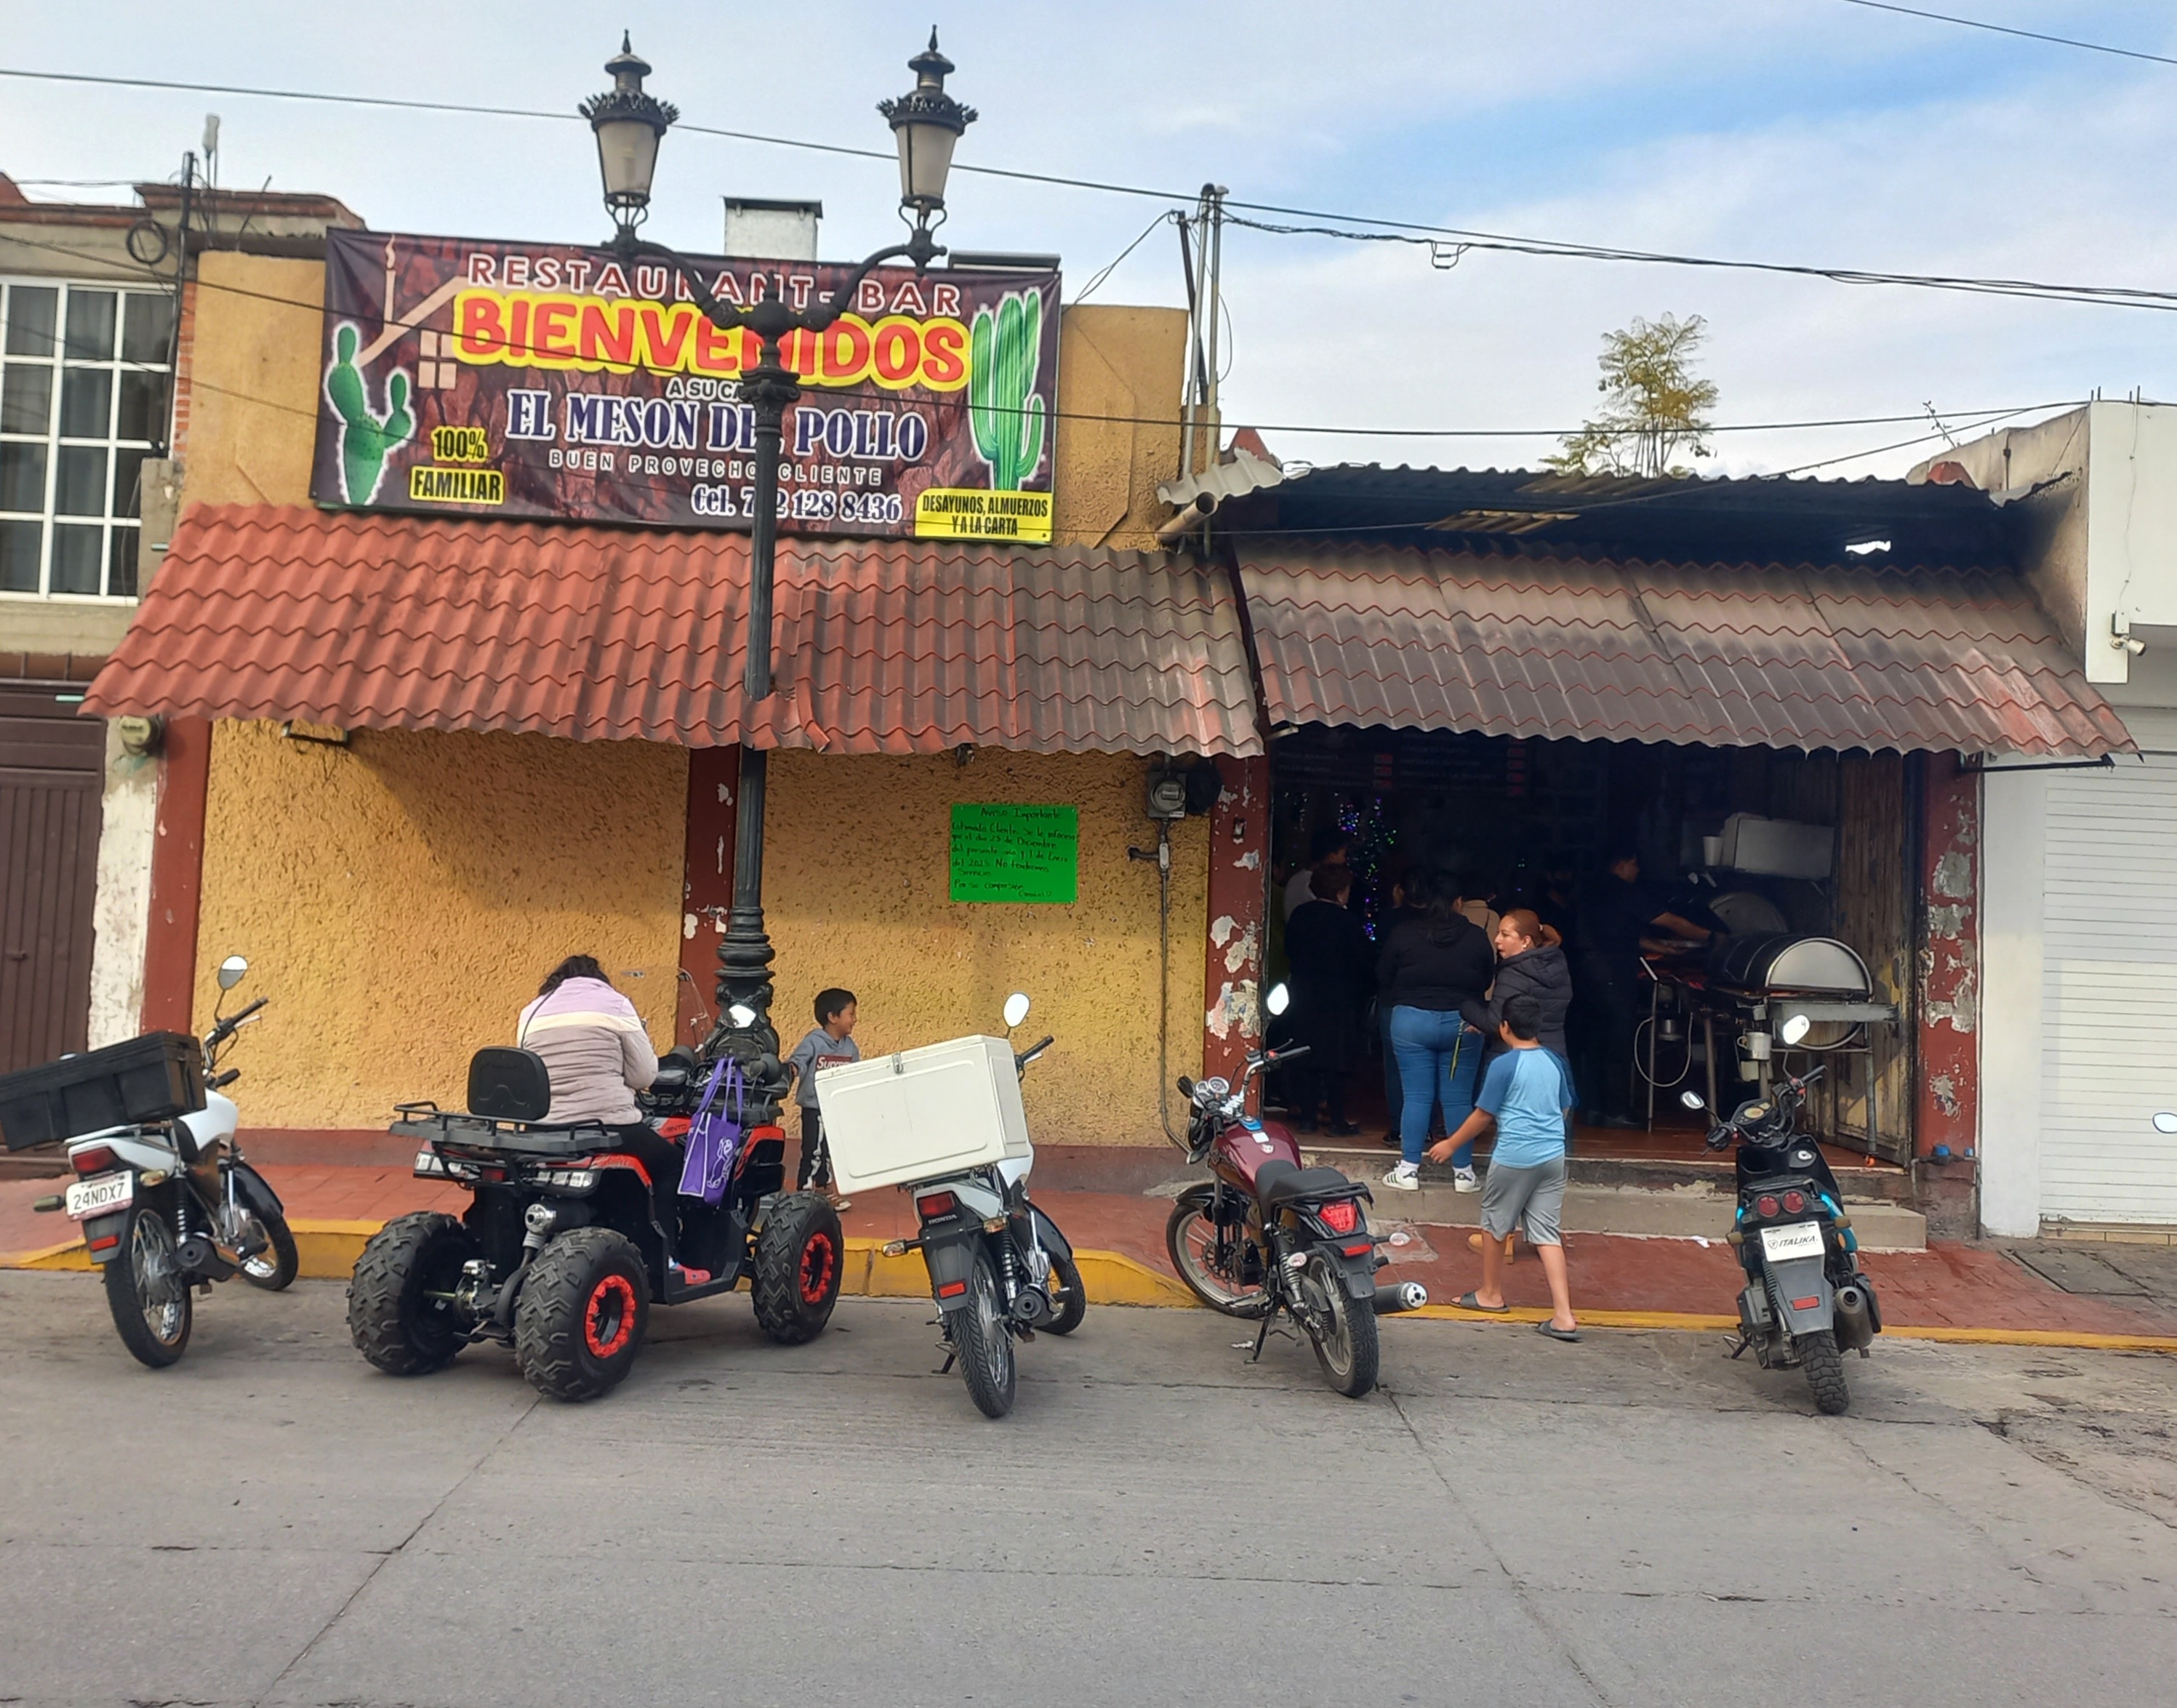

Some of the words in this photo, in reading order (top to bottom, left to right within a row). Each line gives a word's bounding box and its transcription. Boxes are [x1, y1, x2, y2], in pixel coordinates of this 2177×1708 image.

[858, 279, 962, 316] BAR
[666, 377, 685, 398] A
[505, 389, 556, 441] EL
[565, 392, 699, 449] MESON
[706, 402, 785, 454] DE
[793, 407, 928, 461] POLLO
[433, 429, 485, 459] 100%
[549, 449, 614, 470] BUEN
[628, 454, 756, 480] PROVECHO
[777, 462, 882, 485] CLIENTE
[413, 469, 501, 502] FAMILIAR
[691, 483, 737, 517] Cel.
[740, 486, 790, 518] 72
[791, 489, 837, 521] 128
[840, 492, 902, 524] 8436
[922, 494, 986, 516] DESAYUNOS,
[987, 497, 1048, 517] ALMUERZOS
[952, 515, 959, 533] Y
[960, 516, 968, 534] A
[969, 516, 982, 534] LA
[985, 517, 1018, 536] CARTA
[981, 807, 1007, 817] Aviso
[1013, 808, 1062, 822] Importante
[995, 858, 1008, 868] No
[73, 1182, 125, 1210] 24NDX7
[1779, 1235, 1816, 1248] ITALIKA
